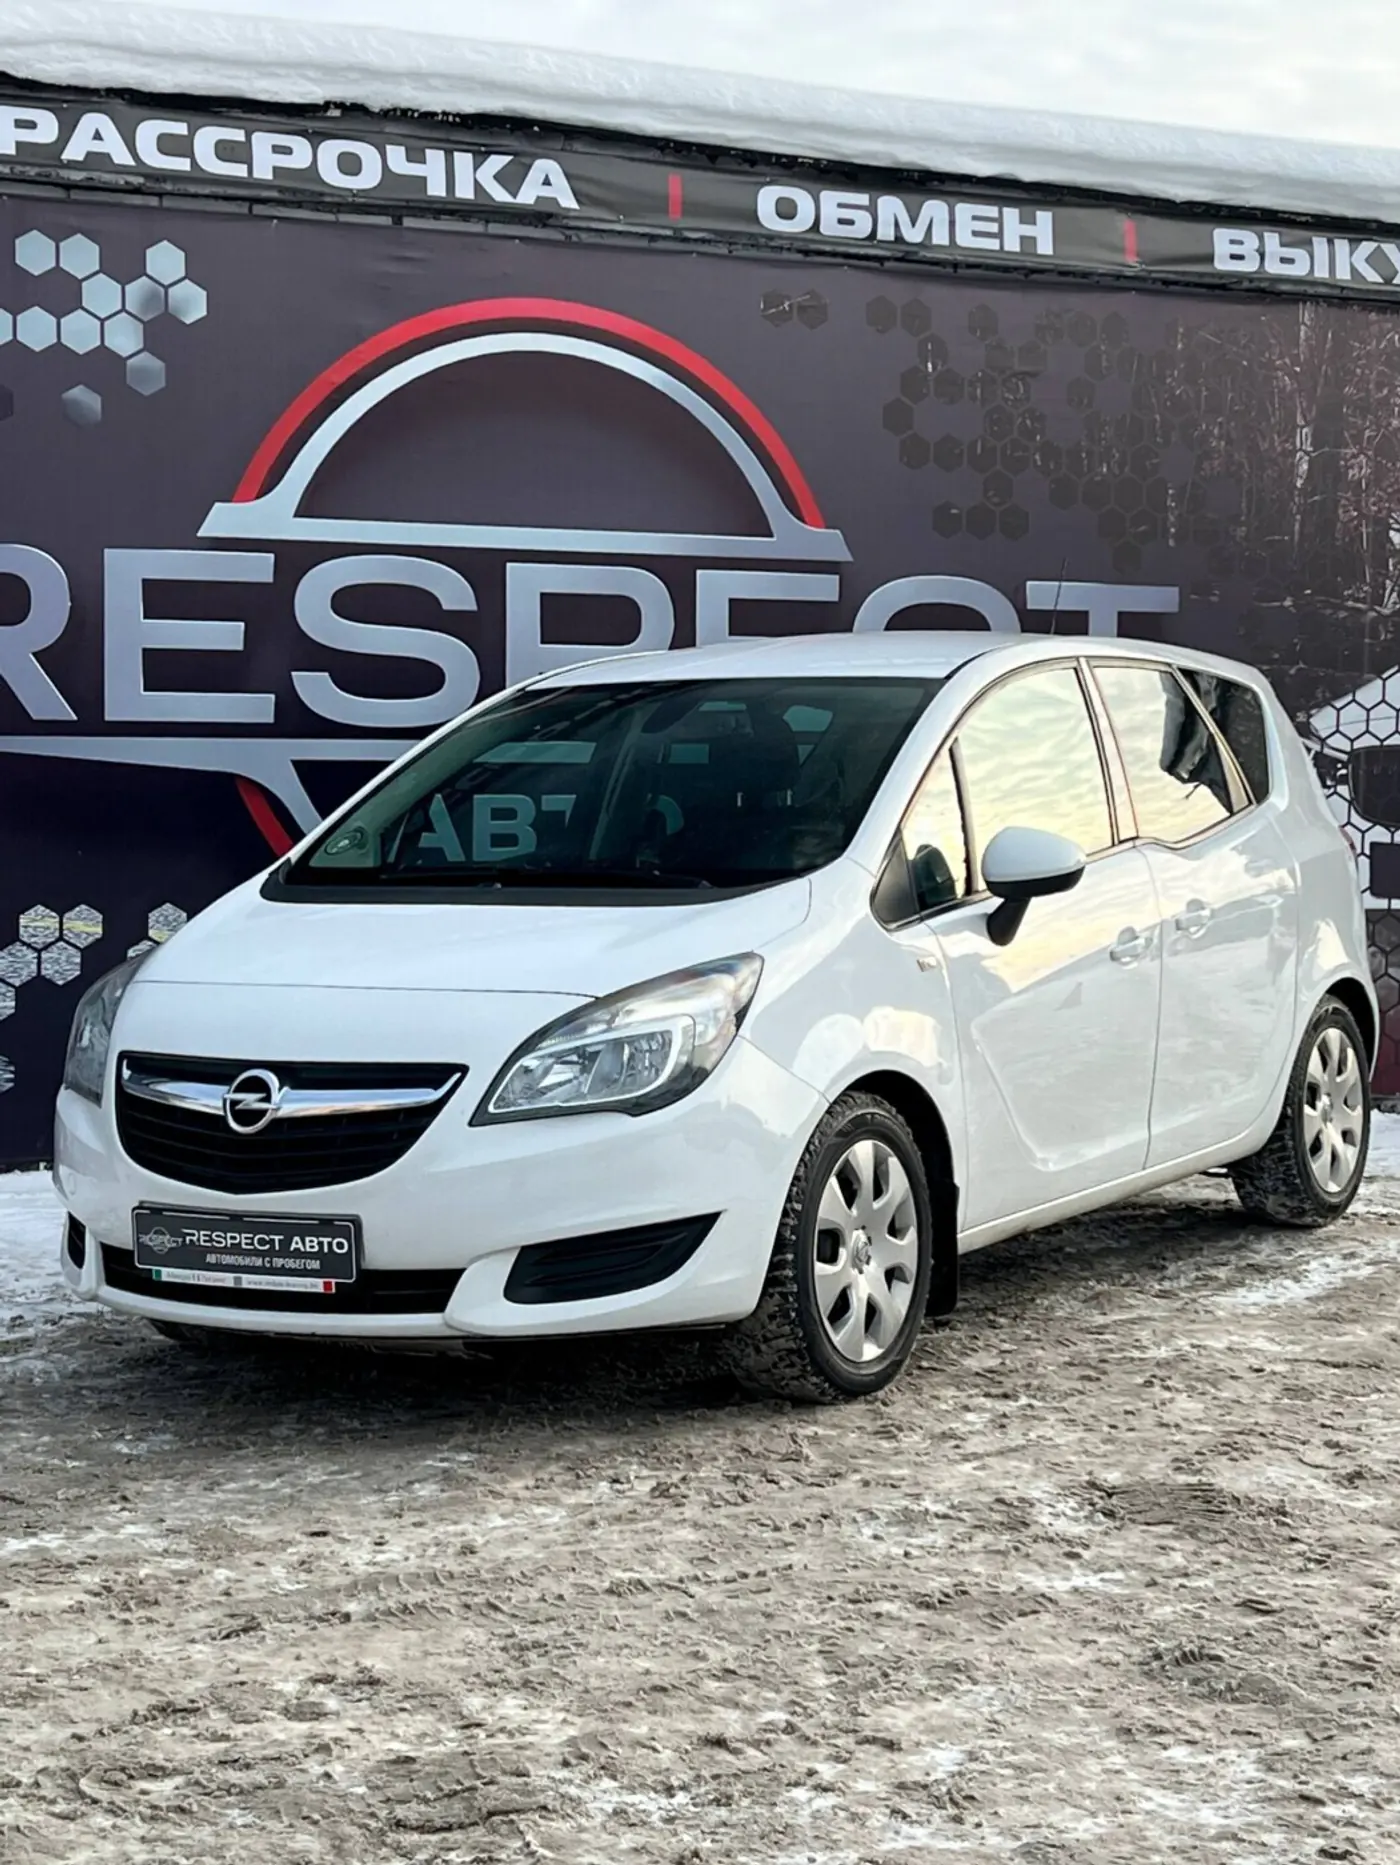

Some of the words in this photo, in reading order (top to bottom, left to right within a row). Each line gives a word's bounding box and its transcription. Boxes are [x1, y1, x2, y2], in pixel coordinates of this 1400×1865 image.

[0, 106, 579, 210] РАССРОЧКА
[756, 185, 1054, 256] ОБМЕН
[181, 1229, 284, 1251] RESPECT
[289, 1236, 348, 1254] АВТО
[205, 1253, 262, 1267] АВТОМОБИЛИ
[264, 1259, 271, 1267] С
[272, 1259, 321, 1270] ПРОБЕГОМ
